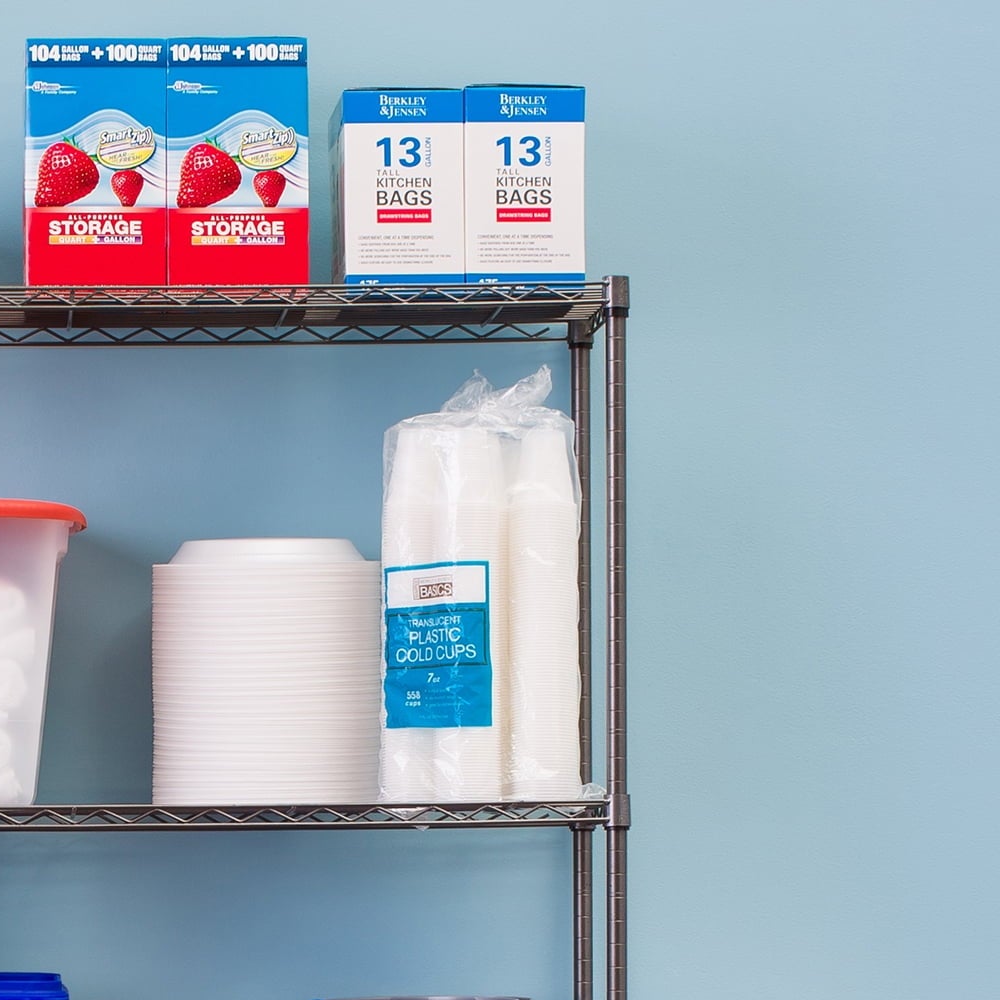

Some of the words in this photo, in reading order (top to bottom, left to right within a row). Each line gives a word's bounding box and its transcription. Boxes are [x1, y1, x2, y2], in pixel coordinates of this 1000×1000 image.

[29, 44, 60, 62] 104
[61, 45, 89, 54] GALLON
[106, 44, 138, 62] 100
[138, 45, 162, 54] QUART
[170, 44, 201, 61] 104
[202, 44, 230, 53] GALLON
[247, 43, 279, 61] 100
[279, 44, 303, 53] QUART
[61, 53, 81, 62] BAGS
[138, 53, 158, 62] BAGS
[202, 53, 222, 61] BAGS
[279, 53, 299, 61] BAGS
[380, 94, 426, 106] BERKLEY
[500, 94, 547, 105] BERKLEY
[100, 128, 133, 144] Smart
[242, 128, 275, 144] Smart
[376, 136, 421, 168] 13
[496, 136, 541, 167] 13
[377, 178, 432, 188] KITCHEN
[496, 177, 552, 187] KITCHEN
[376, 190, 432, 206] BAGS
[496, 189, 552, 205] BAGS
[49, 220, 142, 235] STORAGE
[191, 221, 285, 236] STORAGE
[59, 236, 87, 244] QUART
[409, 627, 461, 645] PLASTIC
[396, 647, 433, 662] COLD
[435, 644, 477, 660] CUPS
[406, 691, 421, 700] 558
